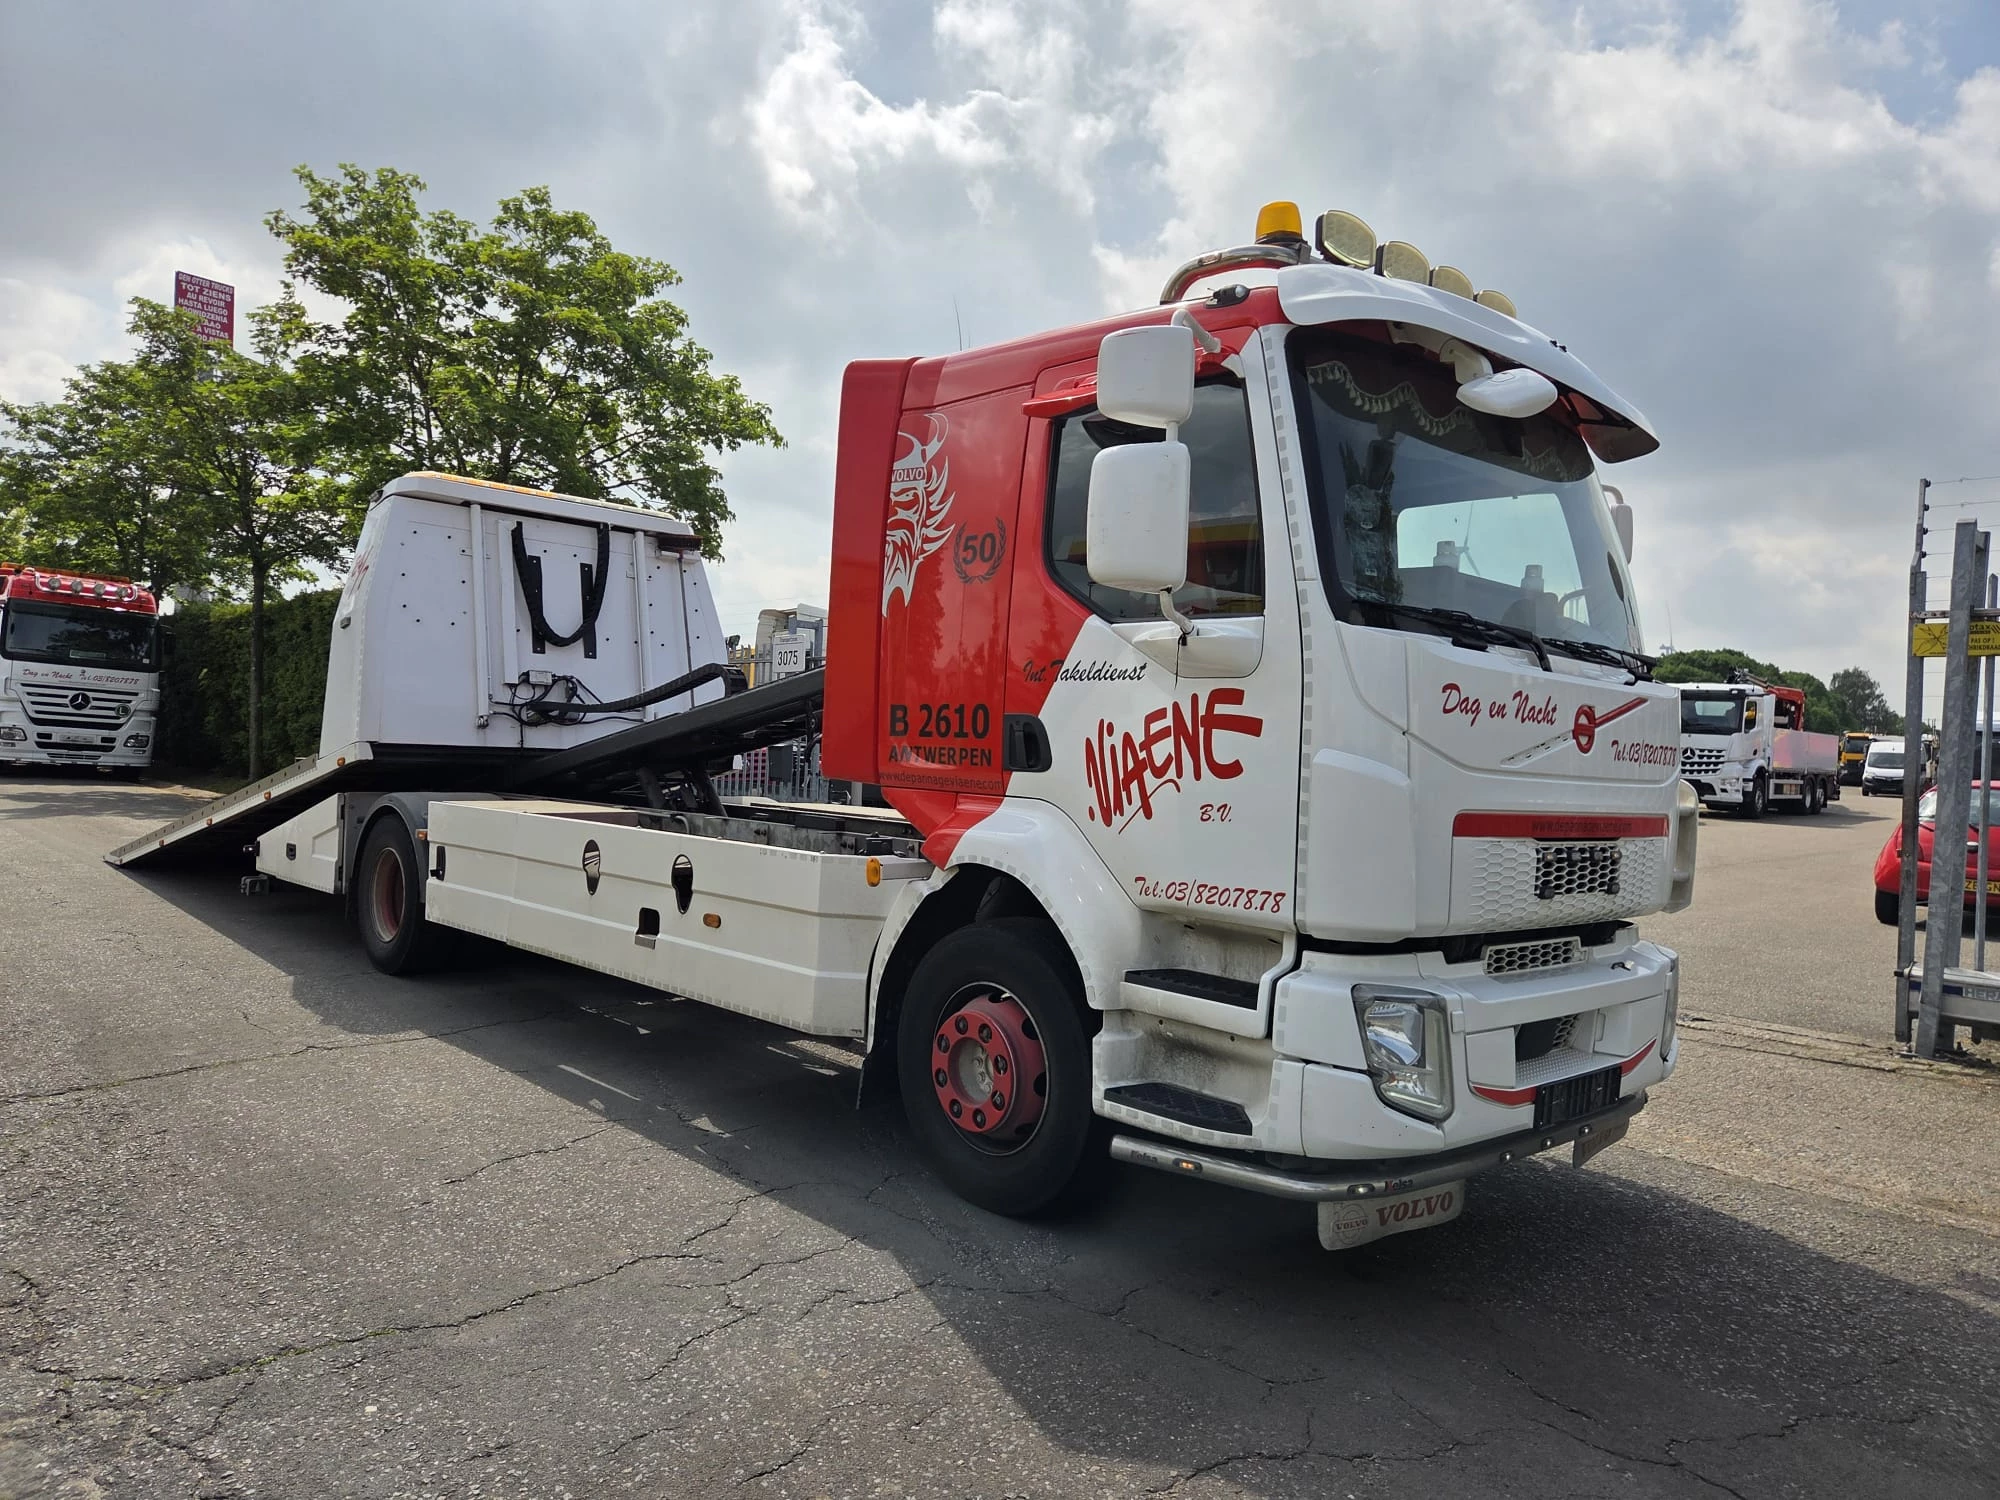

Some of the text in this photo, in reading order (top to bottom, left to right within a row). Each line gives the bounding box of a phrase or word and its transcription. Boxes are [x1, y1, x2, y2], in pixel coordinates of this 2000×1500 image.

[180, 282, 231, 302] TOT ZIENS
[192, 277, 210, 288] OTTER
[178, 297, 228, 316] HASTA LUEGO
[186, 292, 225, 308] AU REVOIR
[203, 327, 229, 339] VISTAS
[892, 467, 924, 482] VOLVO
[961, 532, 997, 566] 50
[777, 650, 799, 666] 3075
[22, 668, 39, 678] Dag
[51, 671, 73, 680] Nacht
[1050, 659, 1148, 683] Takeldienst
[1442, 682, 1558, 728] Dag en Nacht
[888, 703, 990, 739] B 2610
[888, 745, 992, 767] ANTWERPEN
[1200, 803, 1232, 823] B.V.
[1335, 1191, 1454, 1231] VOLVO VOLVO
